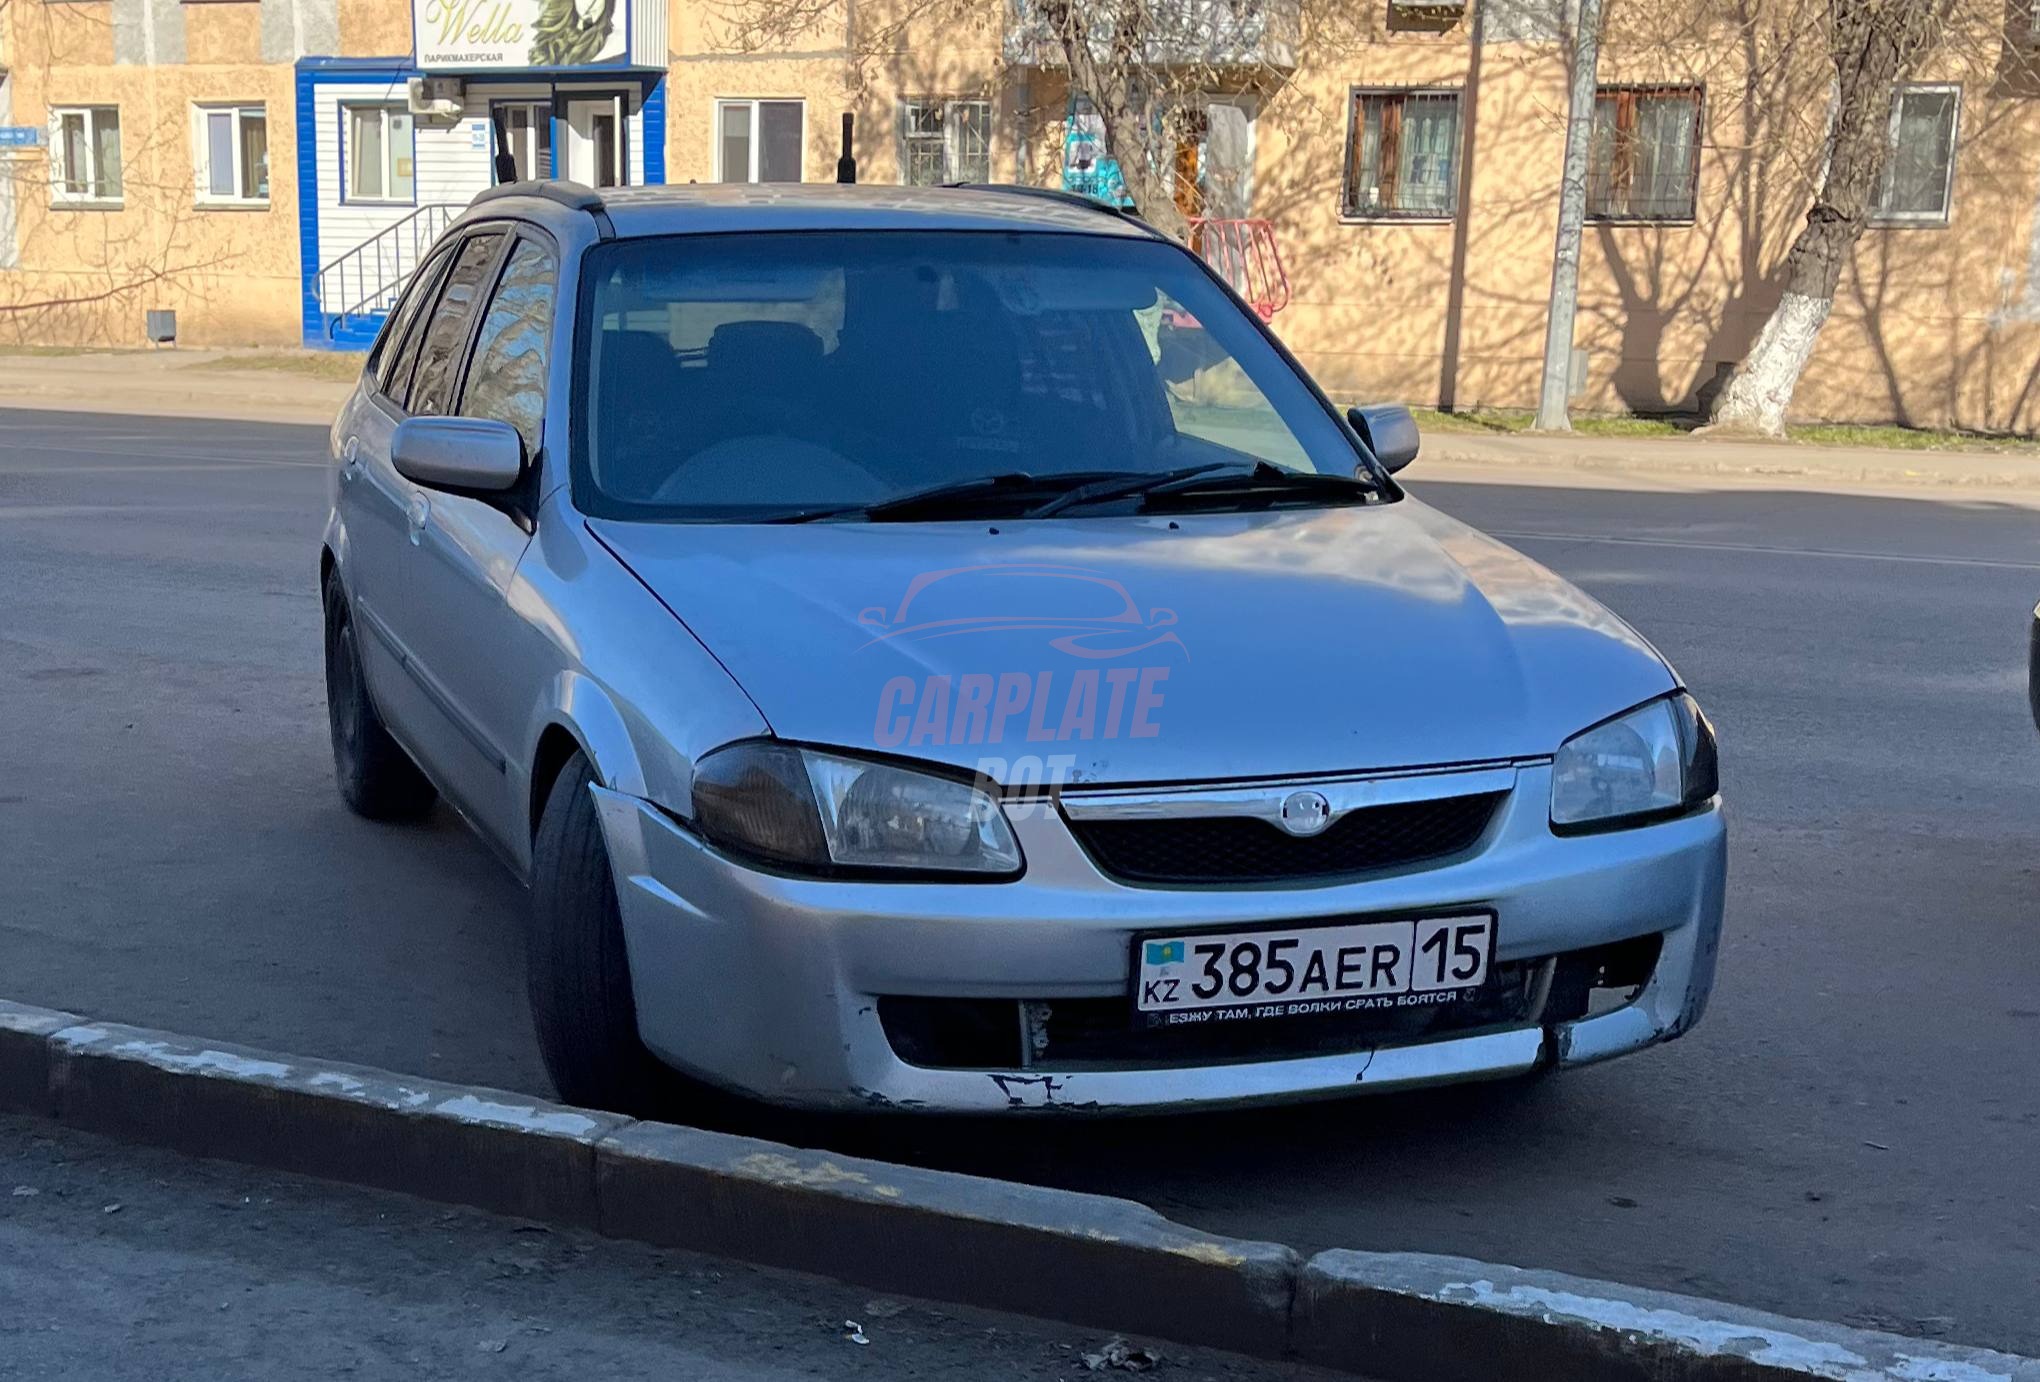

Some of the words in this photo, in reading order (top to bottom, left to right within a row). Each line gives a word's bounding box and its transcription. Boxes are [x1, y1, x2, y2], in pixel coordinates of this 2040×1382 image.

[426, 0, 524, 45] Wella
[424, 53, 504, 63] ПАРИКМАХЕРСКАЯ
[1421, 925, 1486, 983] 15
[1143, 979, 1181, 1004] KZ
[1169, 1011, 1213, 1024] ЕЗЖУ
[1215, 1008, 1252, 1020] ТАМ,
[1255, 1004, 1285, 1017] ГДЕ
[1288, 1002, 1342, 1015] ВОЛКИ
[1345, 997, 1393, 1010] СРАТЬ
[1397, 991, 1457, 1006] БОЯТСЯ
